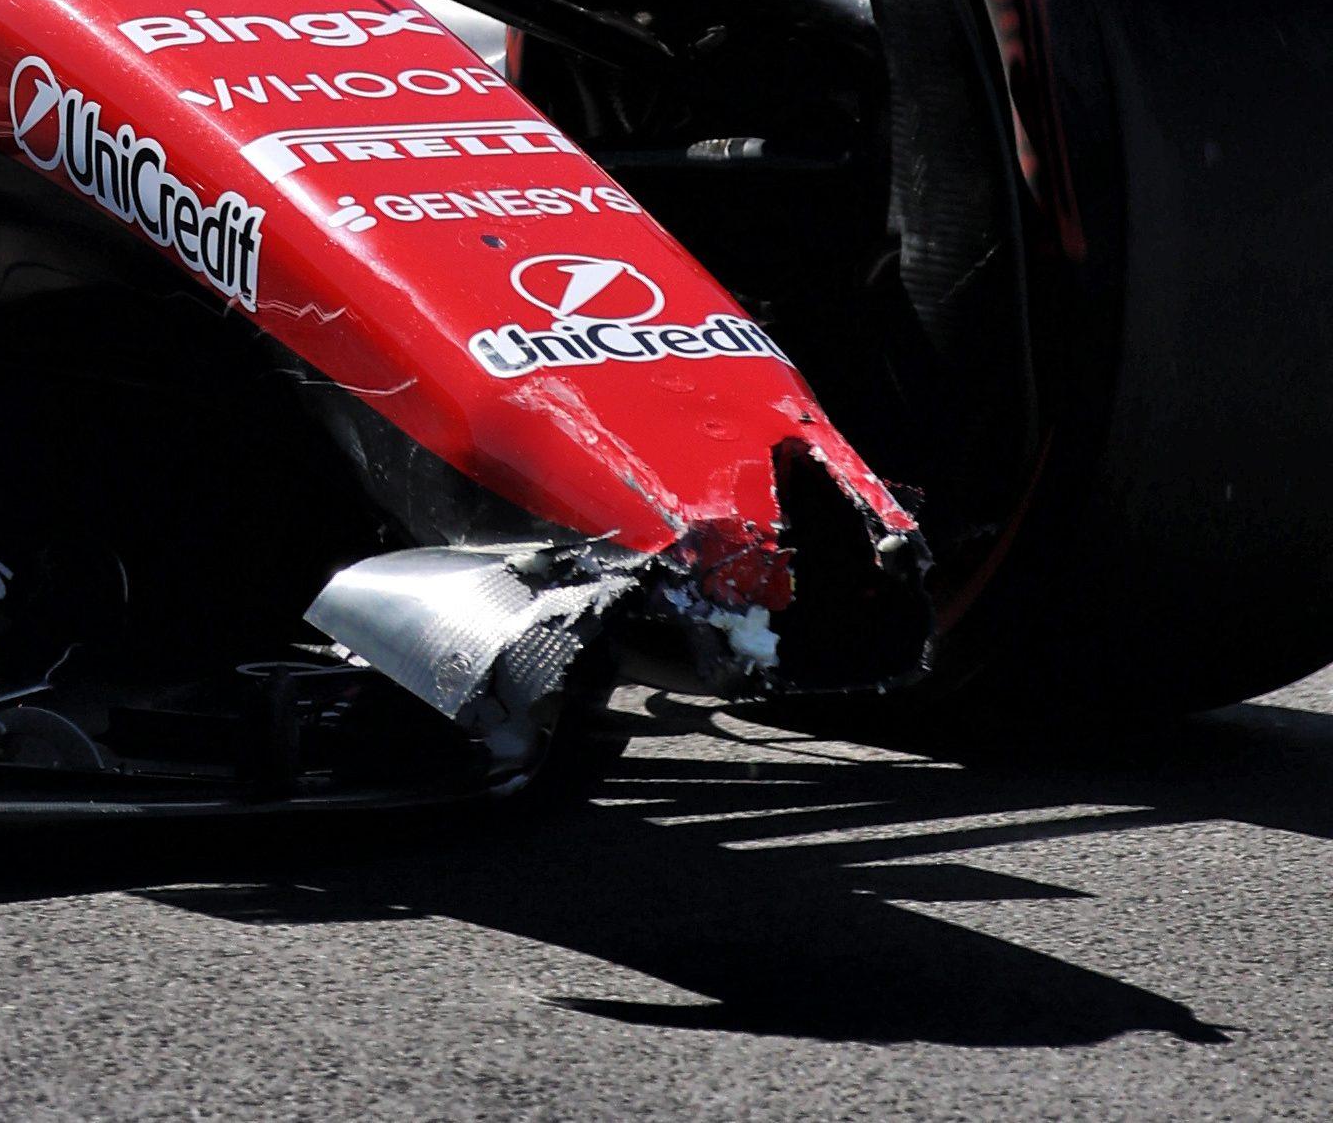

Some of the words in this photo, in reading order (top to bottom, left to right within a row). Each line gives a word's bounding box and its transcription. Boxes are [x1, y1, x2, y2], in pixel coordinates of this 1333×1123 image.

[177, 66, 507, 113] WHOOP
[66, 96, 256, 302] UniCredit
[372, 185, 643, 223] GENESYS
